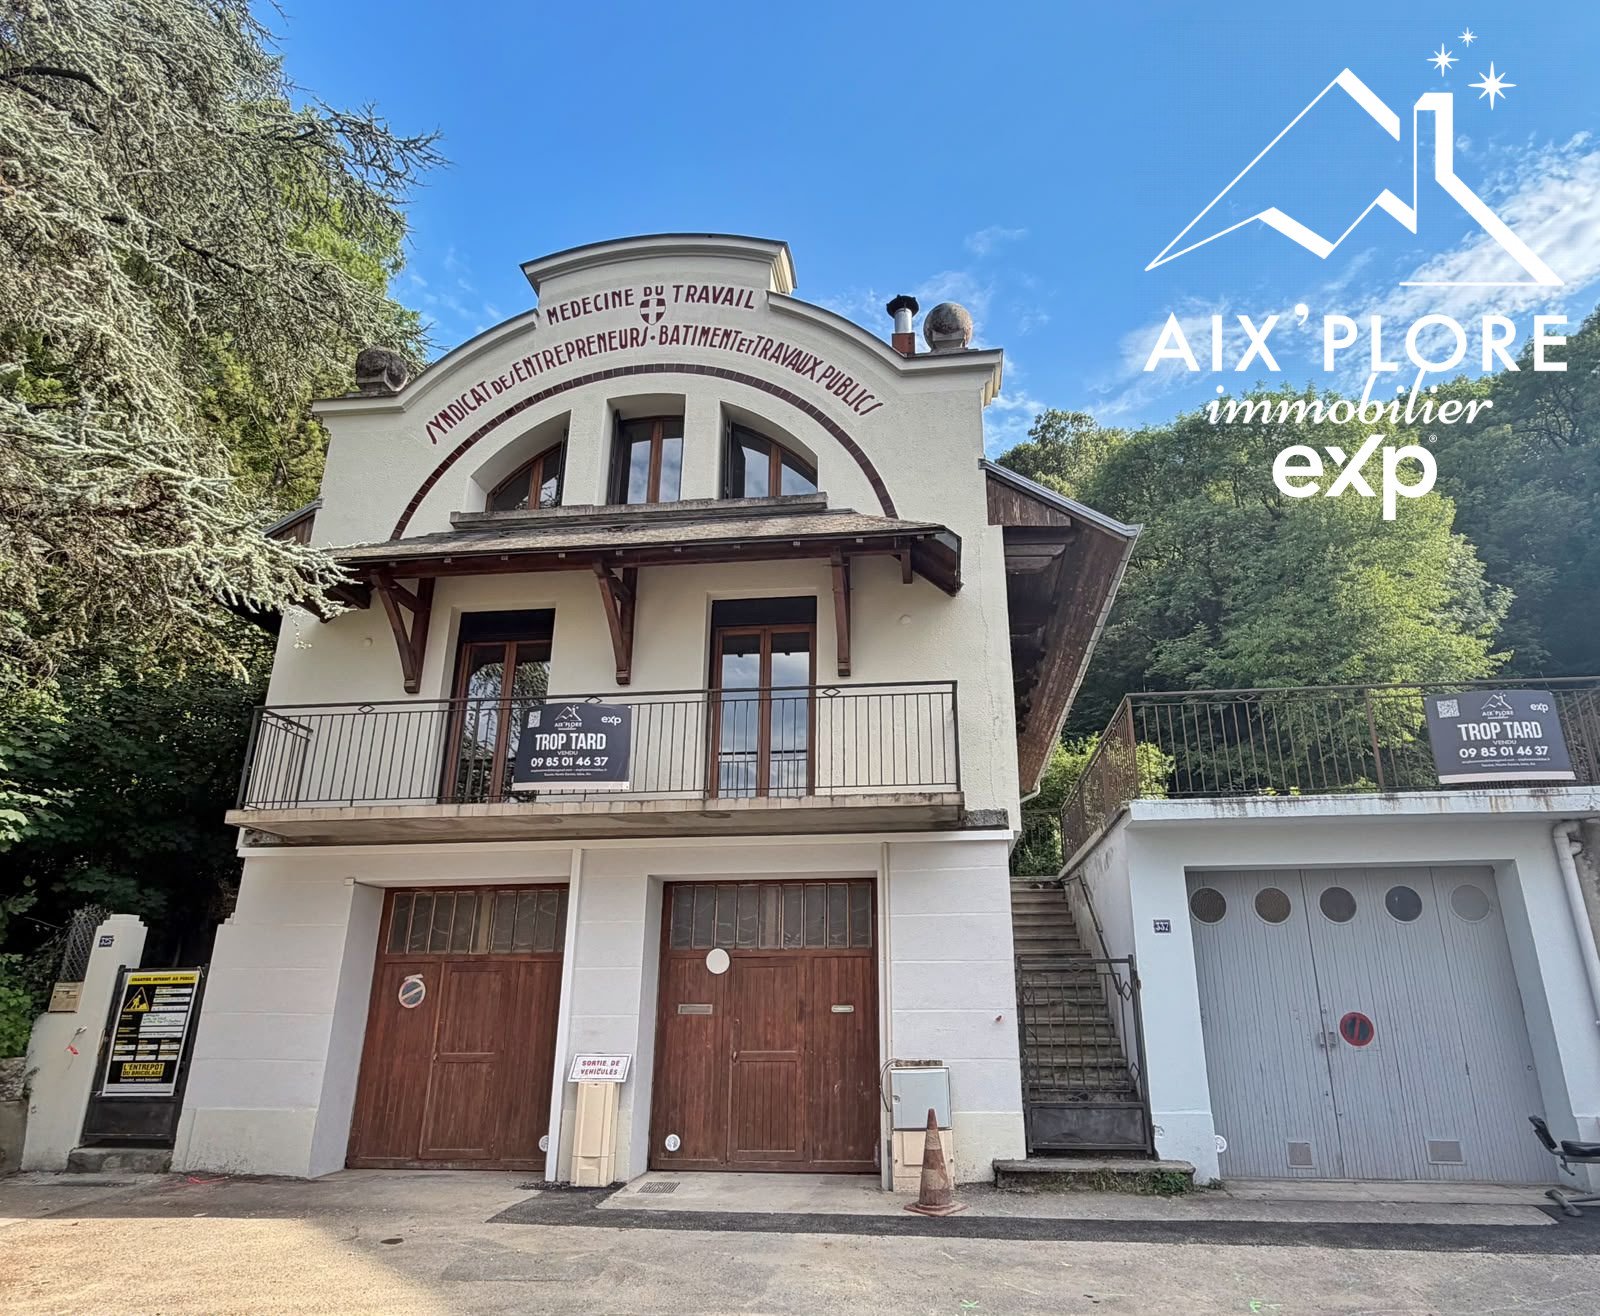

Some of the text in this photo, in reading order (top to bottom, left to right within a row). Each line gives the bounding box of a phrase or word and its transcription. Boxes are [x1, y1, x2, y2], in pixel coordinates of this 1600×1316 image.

[545, 284, 755, 326] MEDECINE DU TRAVAIL
[425, 324, 884, 445] SYNDICAT DES ENTREPRENEURS BATIMENT ET TRAVAUX PUBLICS
[1457, 721, 1543, 742] TROP TARD
[535, 733, 607, 751] TROP TARD
[1459, 745, 1549, 758] 09 85 01 46 37
[530, 756, 608, 767] 09 85 01 46 37
